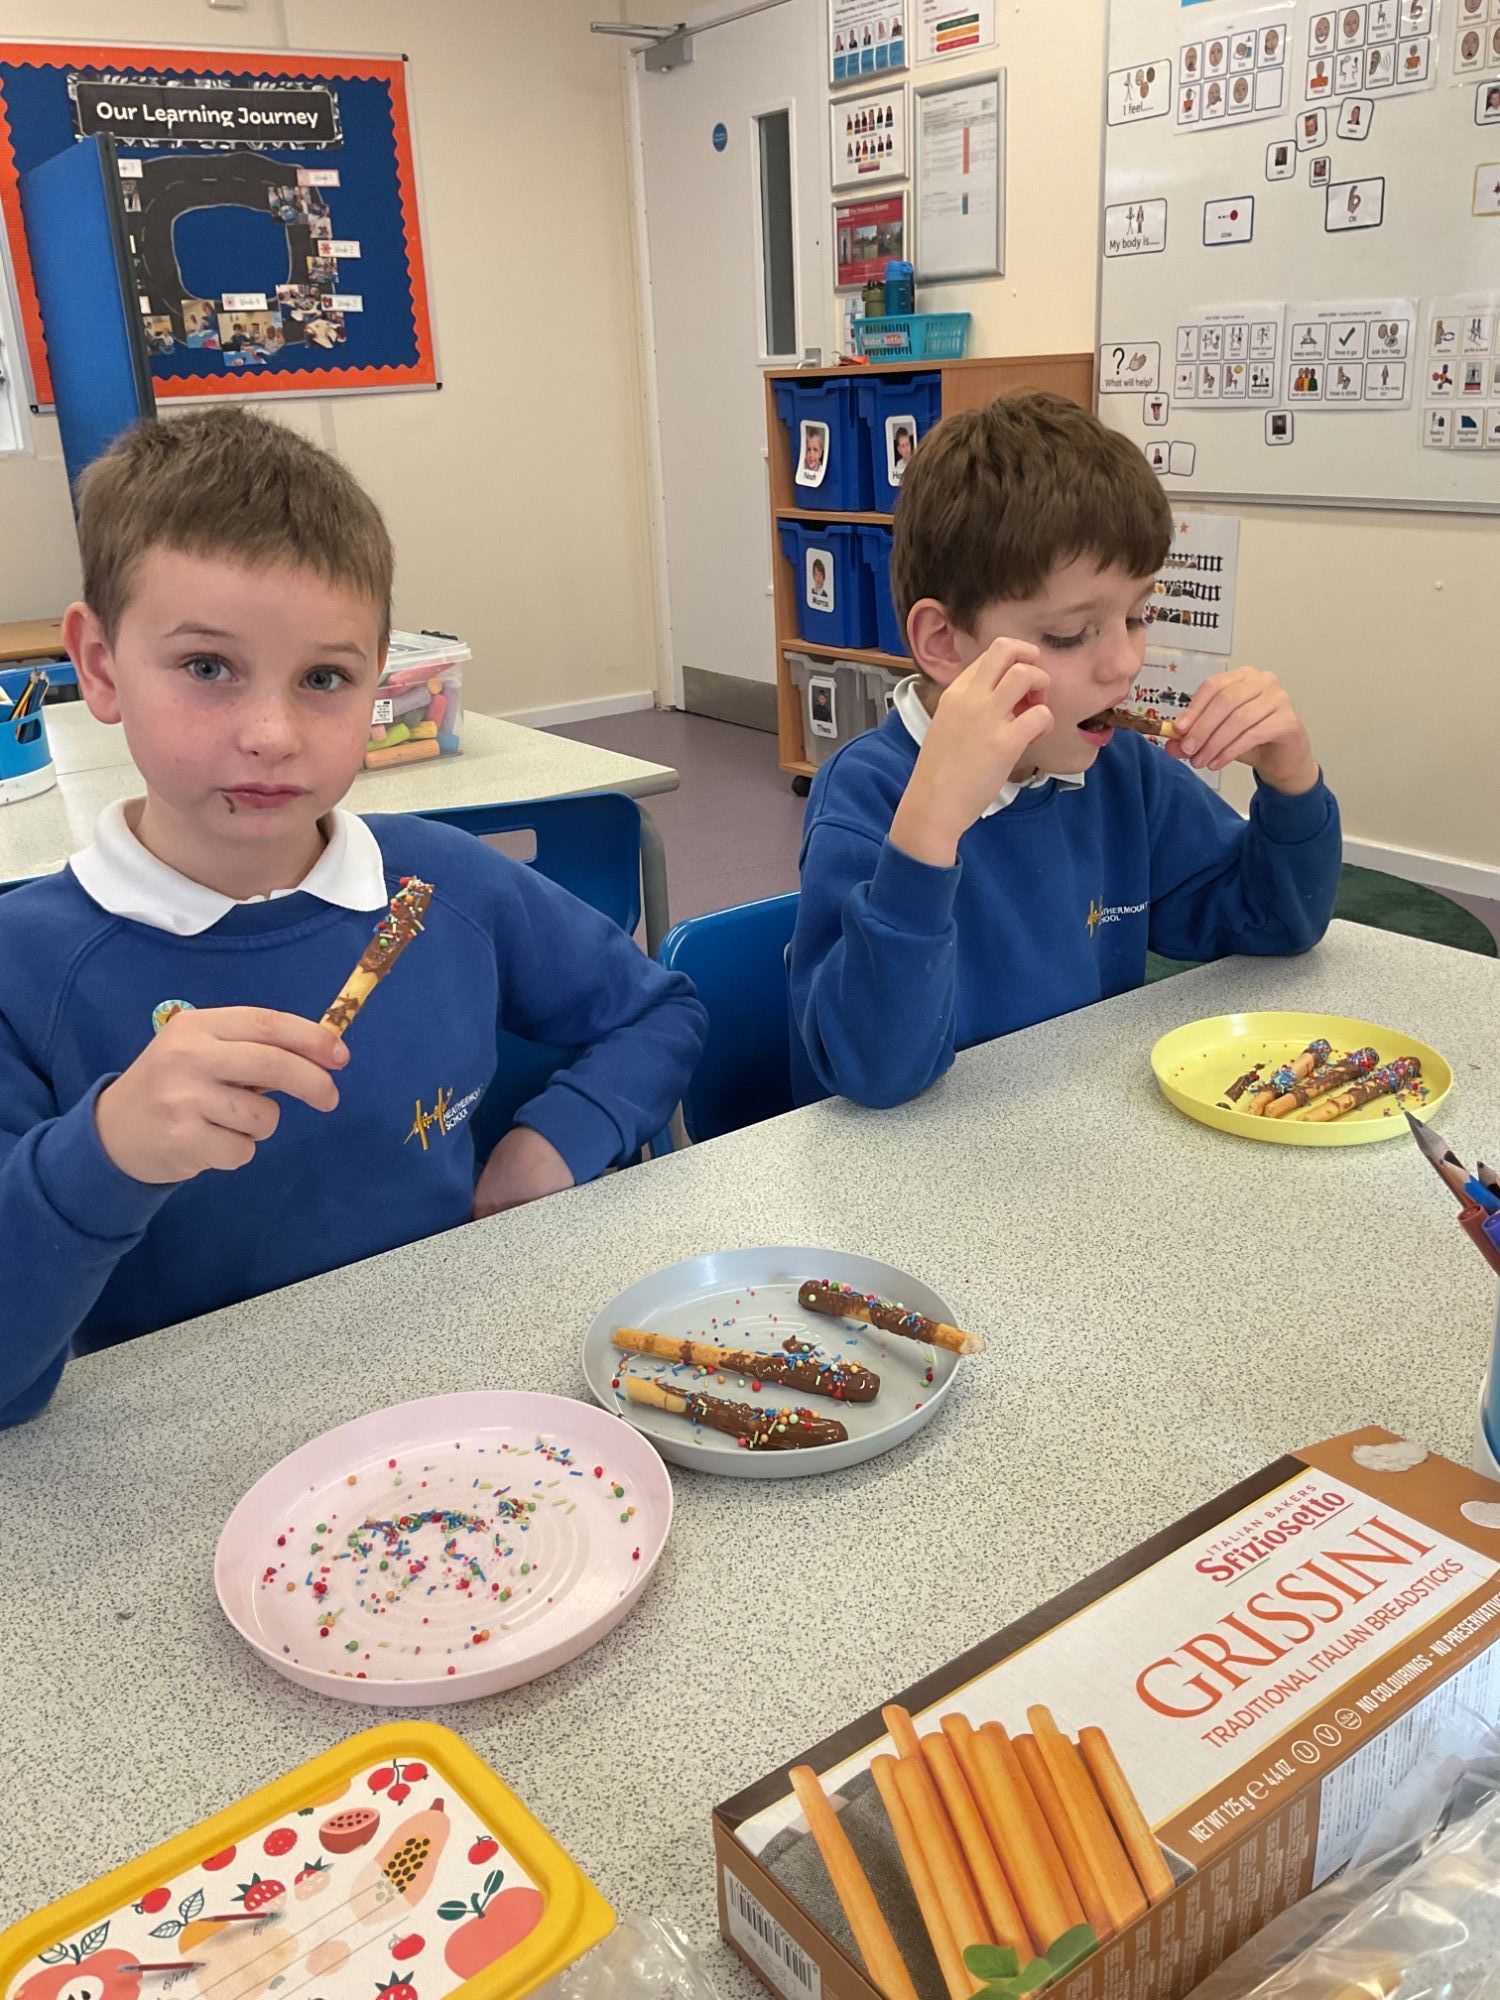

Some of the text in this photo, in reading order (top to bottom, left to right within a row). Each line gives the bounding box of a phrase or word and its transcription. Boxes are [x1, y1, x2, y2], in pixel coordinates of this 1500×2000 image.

[96, 101, 319, 129] Our Learning Journey
[1109, 239, 1121, 252] My
[1122, 237, 1142, 250] body
[1105, 376, 1153, 389] What will help?
[1194, 1491, 1347, 1583] Sfiziosetto
[1207, 1483, 1318, 1558] ITALIAN BAKERS
[1135, 1515, 1438, 1720] GRISSINI
[1200, 1557, 1465, 1749] TRADITIONAL ITALIAN BREADSTICKS
[1355, 1694, 1379, 1714] NO
[1370, 1653, 1434, 1703] COLOURINGS
[1429, 1640, 1453, 1657] NO
[1188, 1819, 1215, 1844] NET
[1204, 1809, 1229, 1830] WT
[1219, 1796, 1245, 1819] 125
